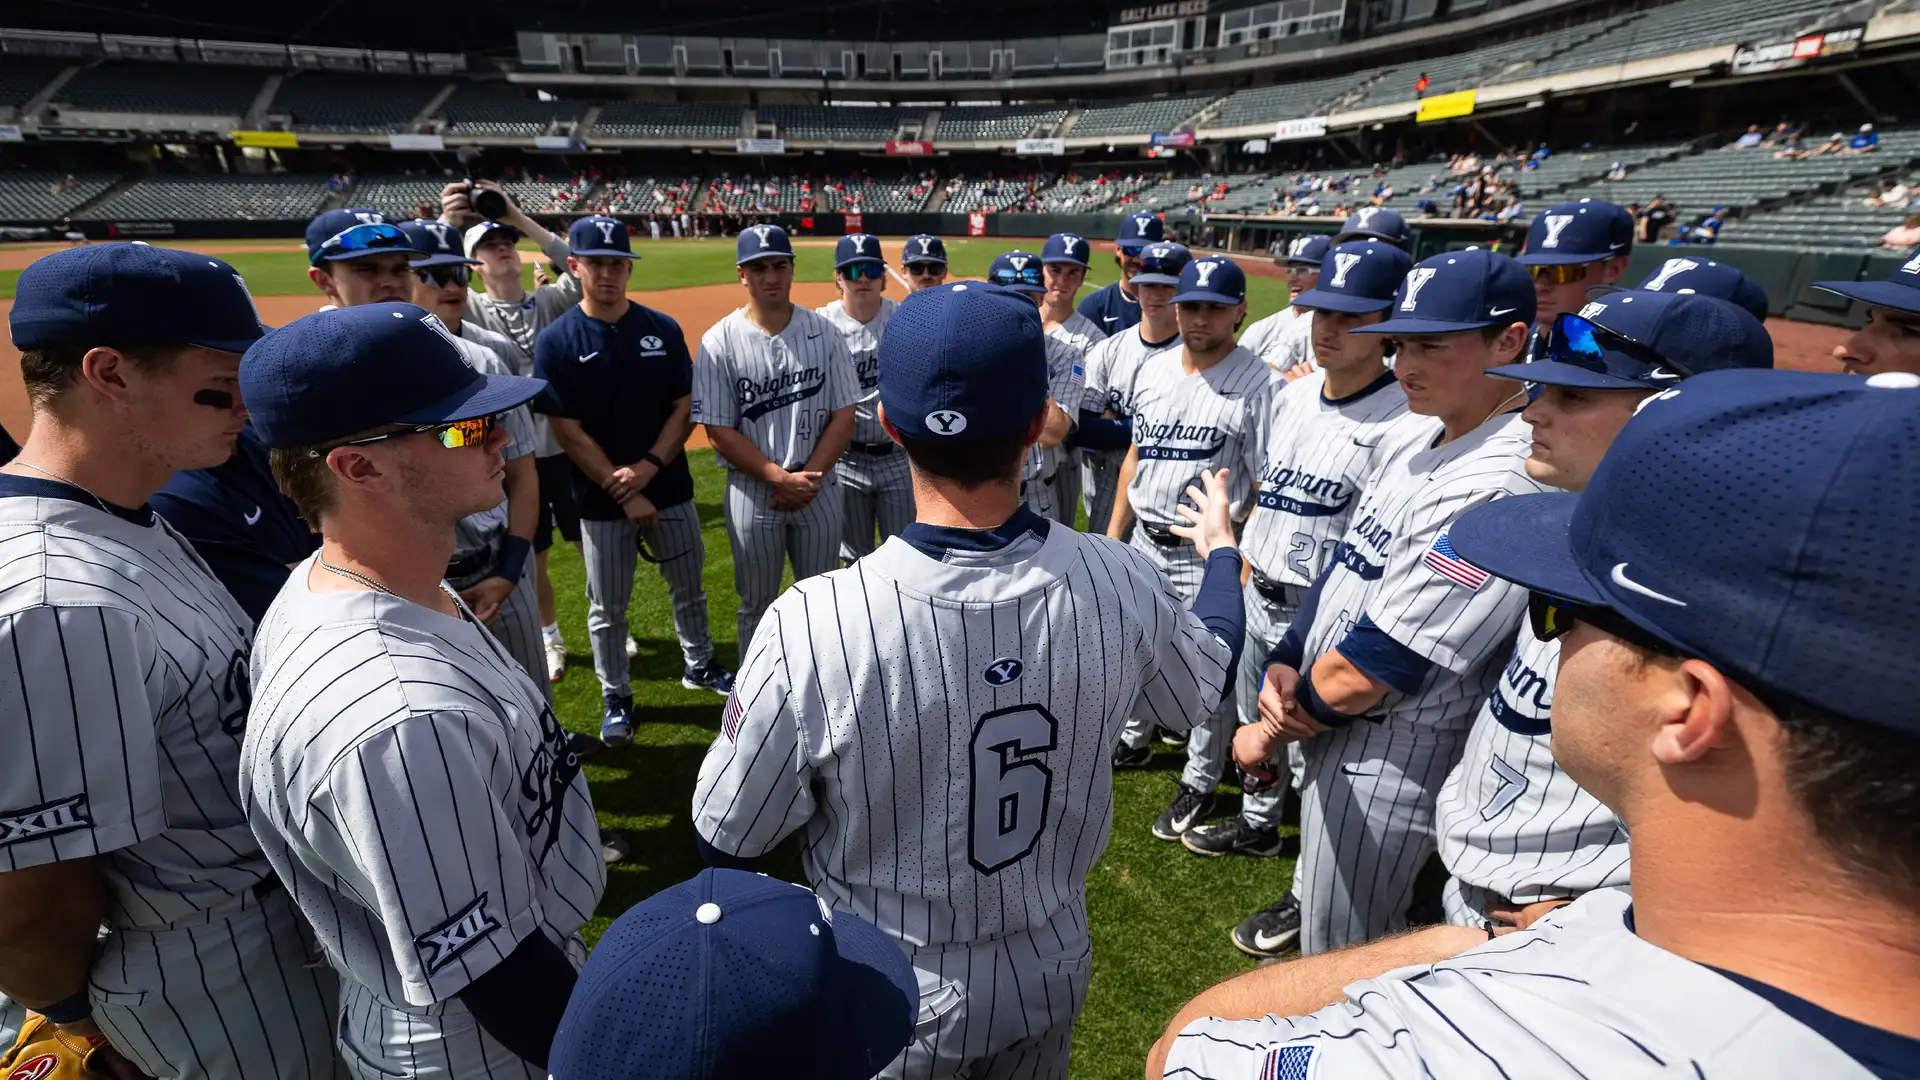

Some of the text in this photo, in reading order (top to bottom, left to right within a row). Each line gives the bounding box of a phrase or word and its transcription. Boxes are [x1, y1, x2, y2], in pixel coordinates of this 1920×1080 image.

[1120, 7, 1146, 23] SALT
[1147, 3, 1177, 18] LAKE
[1136, 217, 1150, 236] Y
[1357, 207, 1379, 229] Y
[424, 224, 450, 250] Y
[596, 221, 615, 244] Y
[753, 227, 771, 248] Y
[1541, 215, 1574, 248] Y
[851, 235, 867, 253] Y
[918, 238, 932, 255] Y
[1062, 236, 1079, 255] Y
[1196, 261, 1219, 288] Y
[1330, 253, 1361, 288] Y
[1644, 257, 1699, 292] Y
[1400, 267, 1437, 312] Y
[737, 366, 825, 406] Brigham
[765, 392, 804, 409] YOUNG
[932, 412, 960, 432] Y
[1145, 448, 1189, 459] YOUNG
[1259, 494, 1303, 514] YOUNG
[991, 661, 1016, 683] Y
[967, 702, 1059, 877] 6
[1480, 753, 1530, 822] 7
[420, 898, 495, 973] XII
